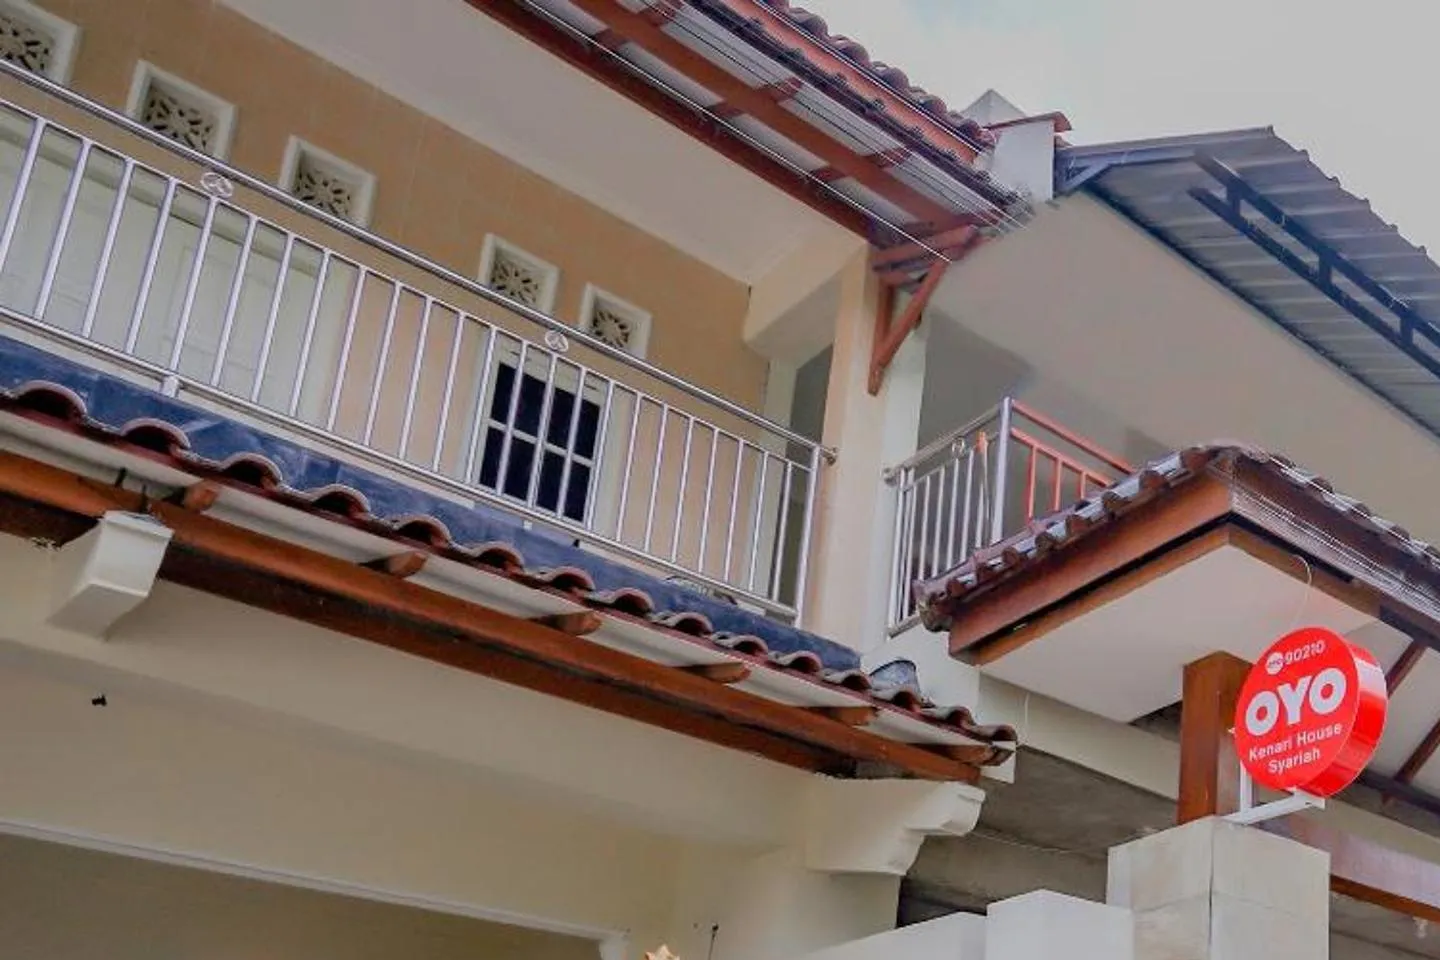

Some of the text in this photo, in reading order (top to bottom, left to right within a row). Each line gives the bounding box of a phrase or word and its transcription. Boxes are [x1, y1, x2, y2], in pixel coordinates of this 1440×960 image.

[1245, 667, 1347, 736] OYO
[1249, 723, 1342, 762] Kenari House
[1268, 747, 1321, 776] Syariah
